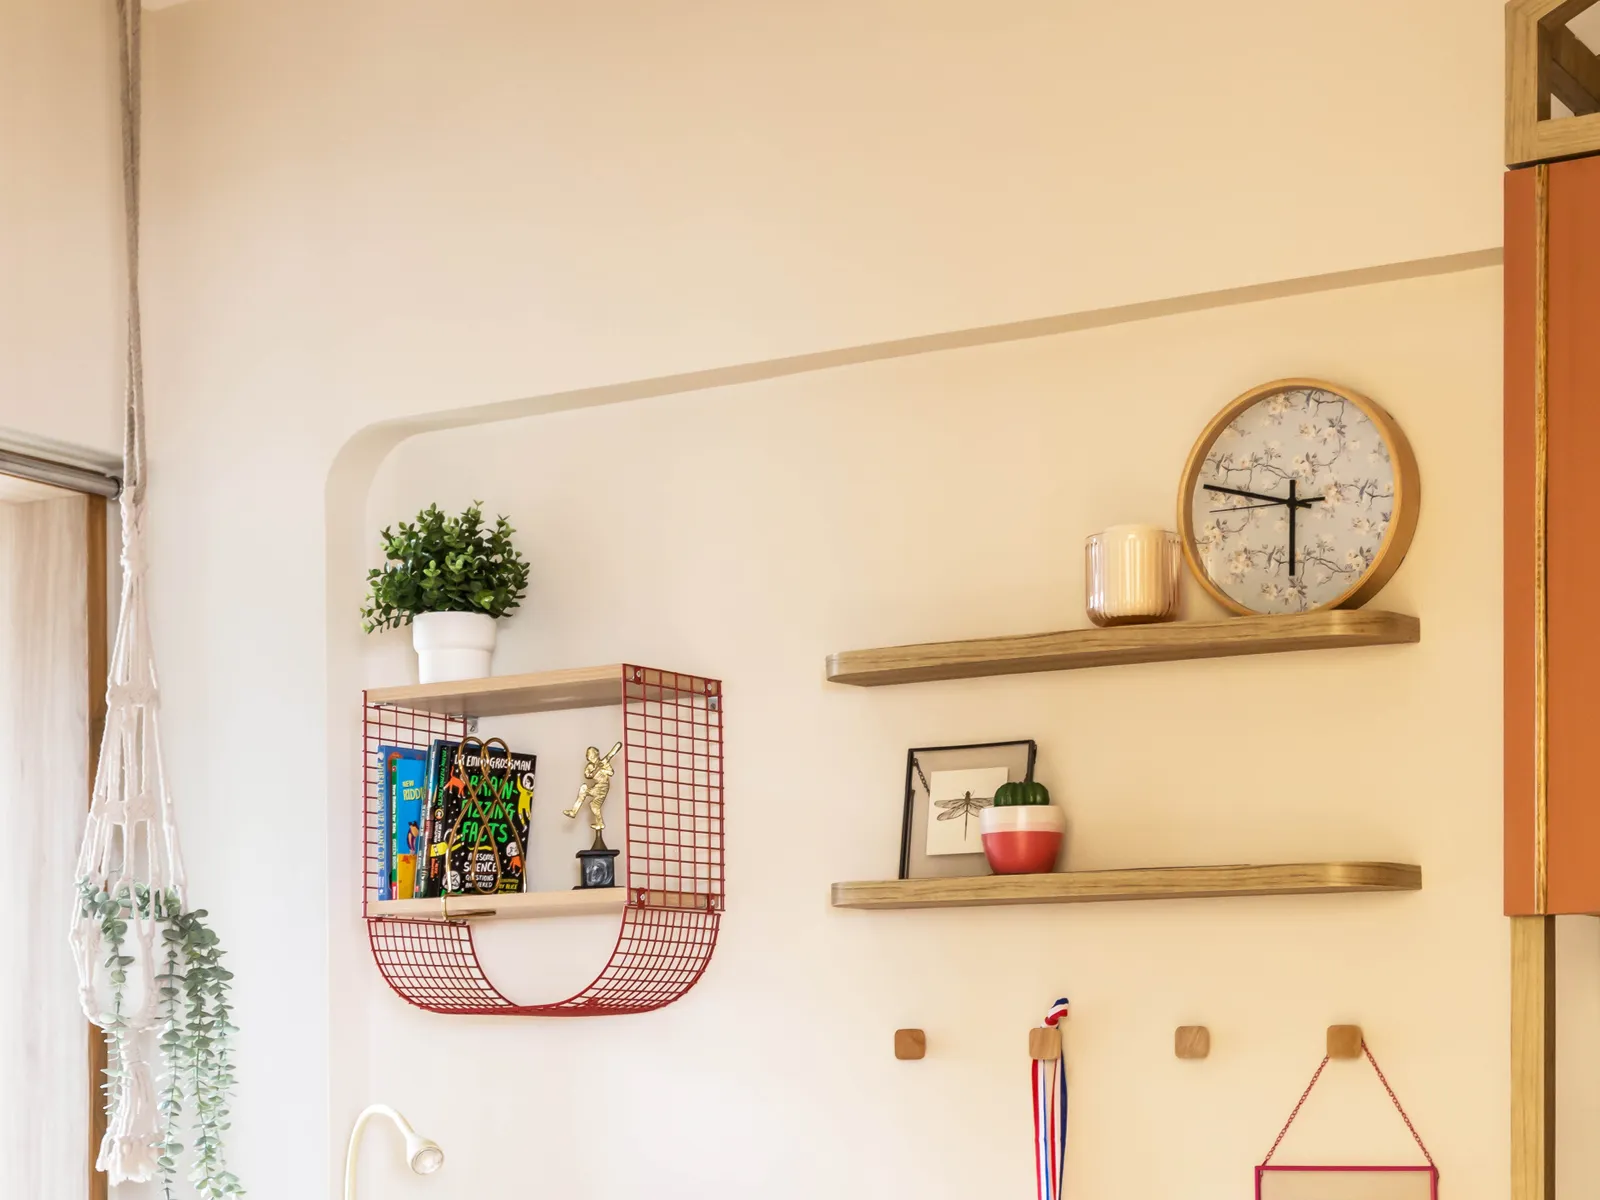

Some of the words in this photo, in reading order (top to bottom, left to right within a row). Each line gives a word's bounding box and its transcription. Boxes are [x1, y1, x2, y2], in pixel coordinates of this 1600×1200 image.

[466, 756, 488, 768] EMIY
[467, 853, 495, 861] AESOME
[463, 861, 497, 872] SENCE
